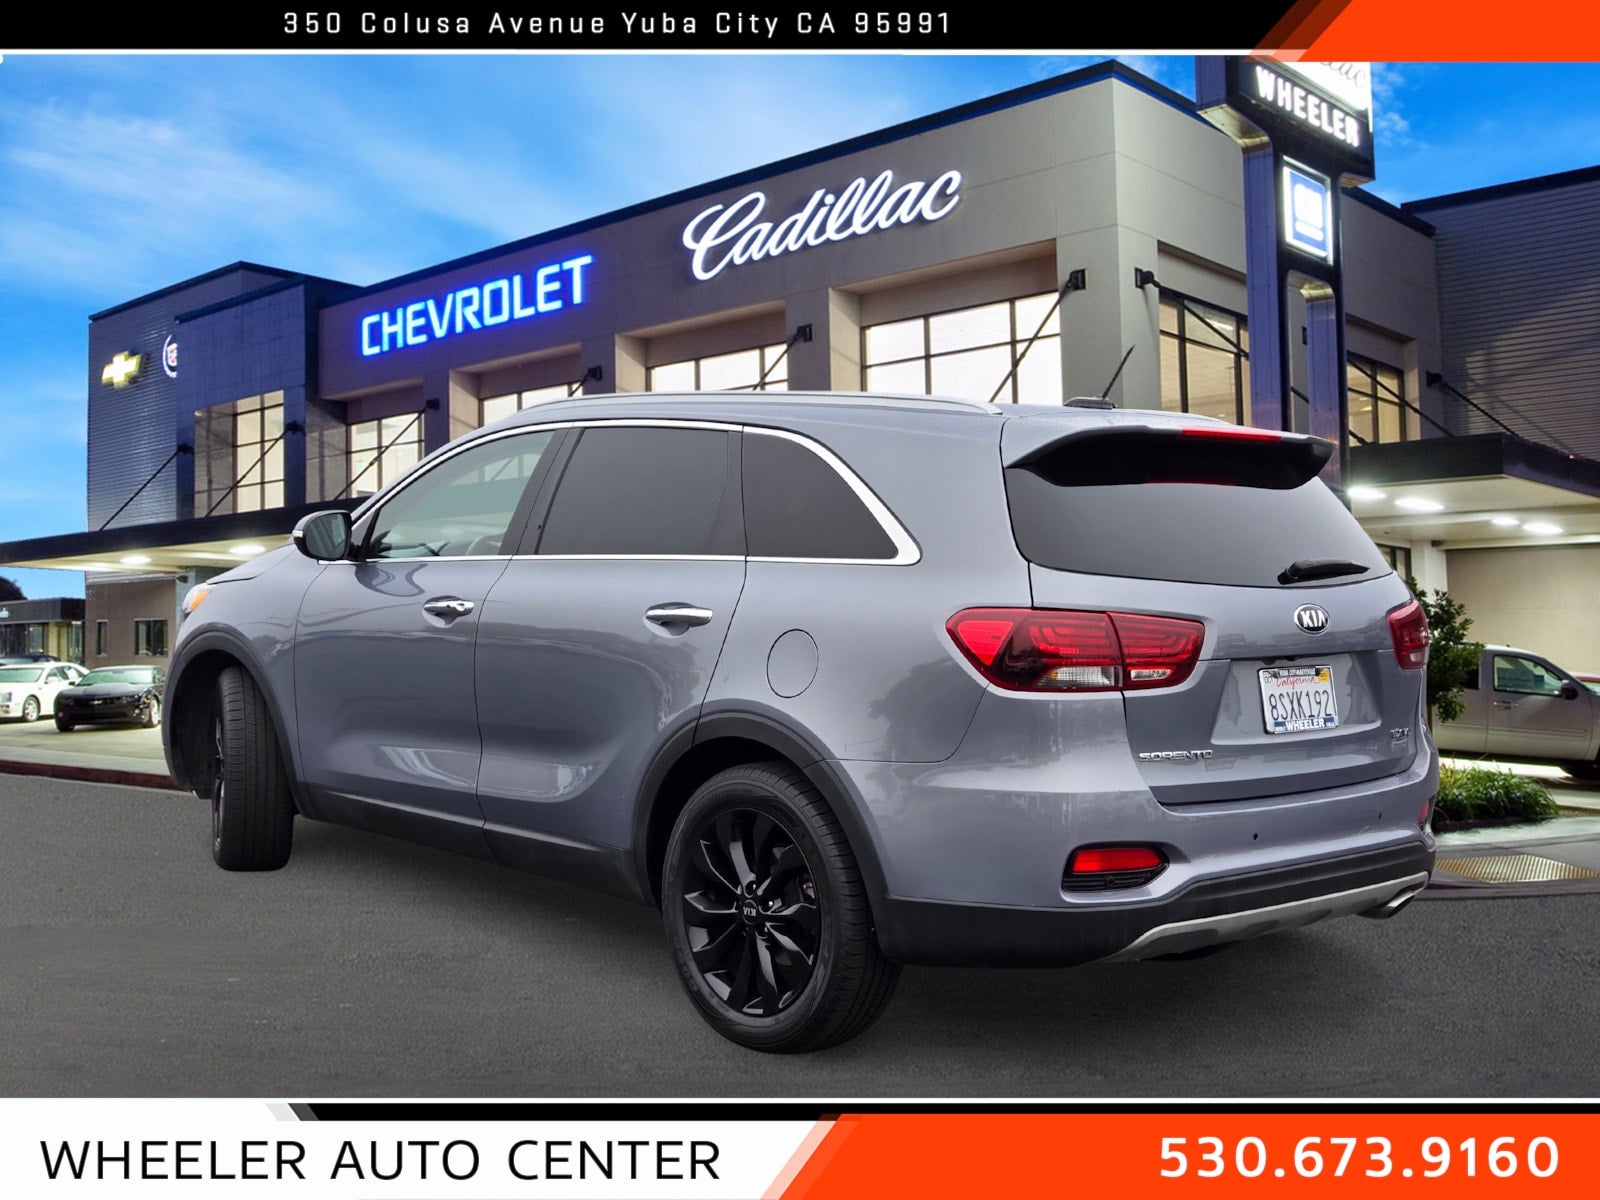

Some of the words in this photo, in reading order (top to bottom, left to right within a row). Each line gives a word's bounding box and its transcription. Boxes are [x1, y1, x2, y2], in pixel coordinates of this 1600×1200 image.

[1255, 65, 1359, 147] WHEELER
[682, 169, 963, 281] Cadillac
[361, 254, 593, 357] CHEVROLET
[1300, 610, 1327, 628] KIA
[1268, 689, 1332, 721] 8SXK192
[1285, 718, 1325, 732] WHEELER
[1138, 749, 1214, 762] SORENTO
[744, 907, 757, 917] KIA
